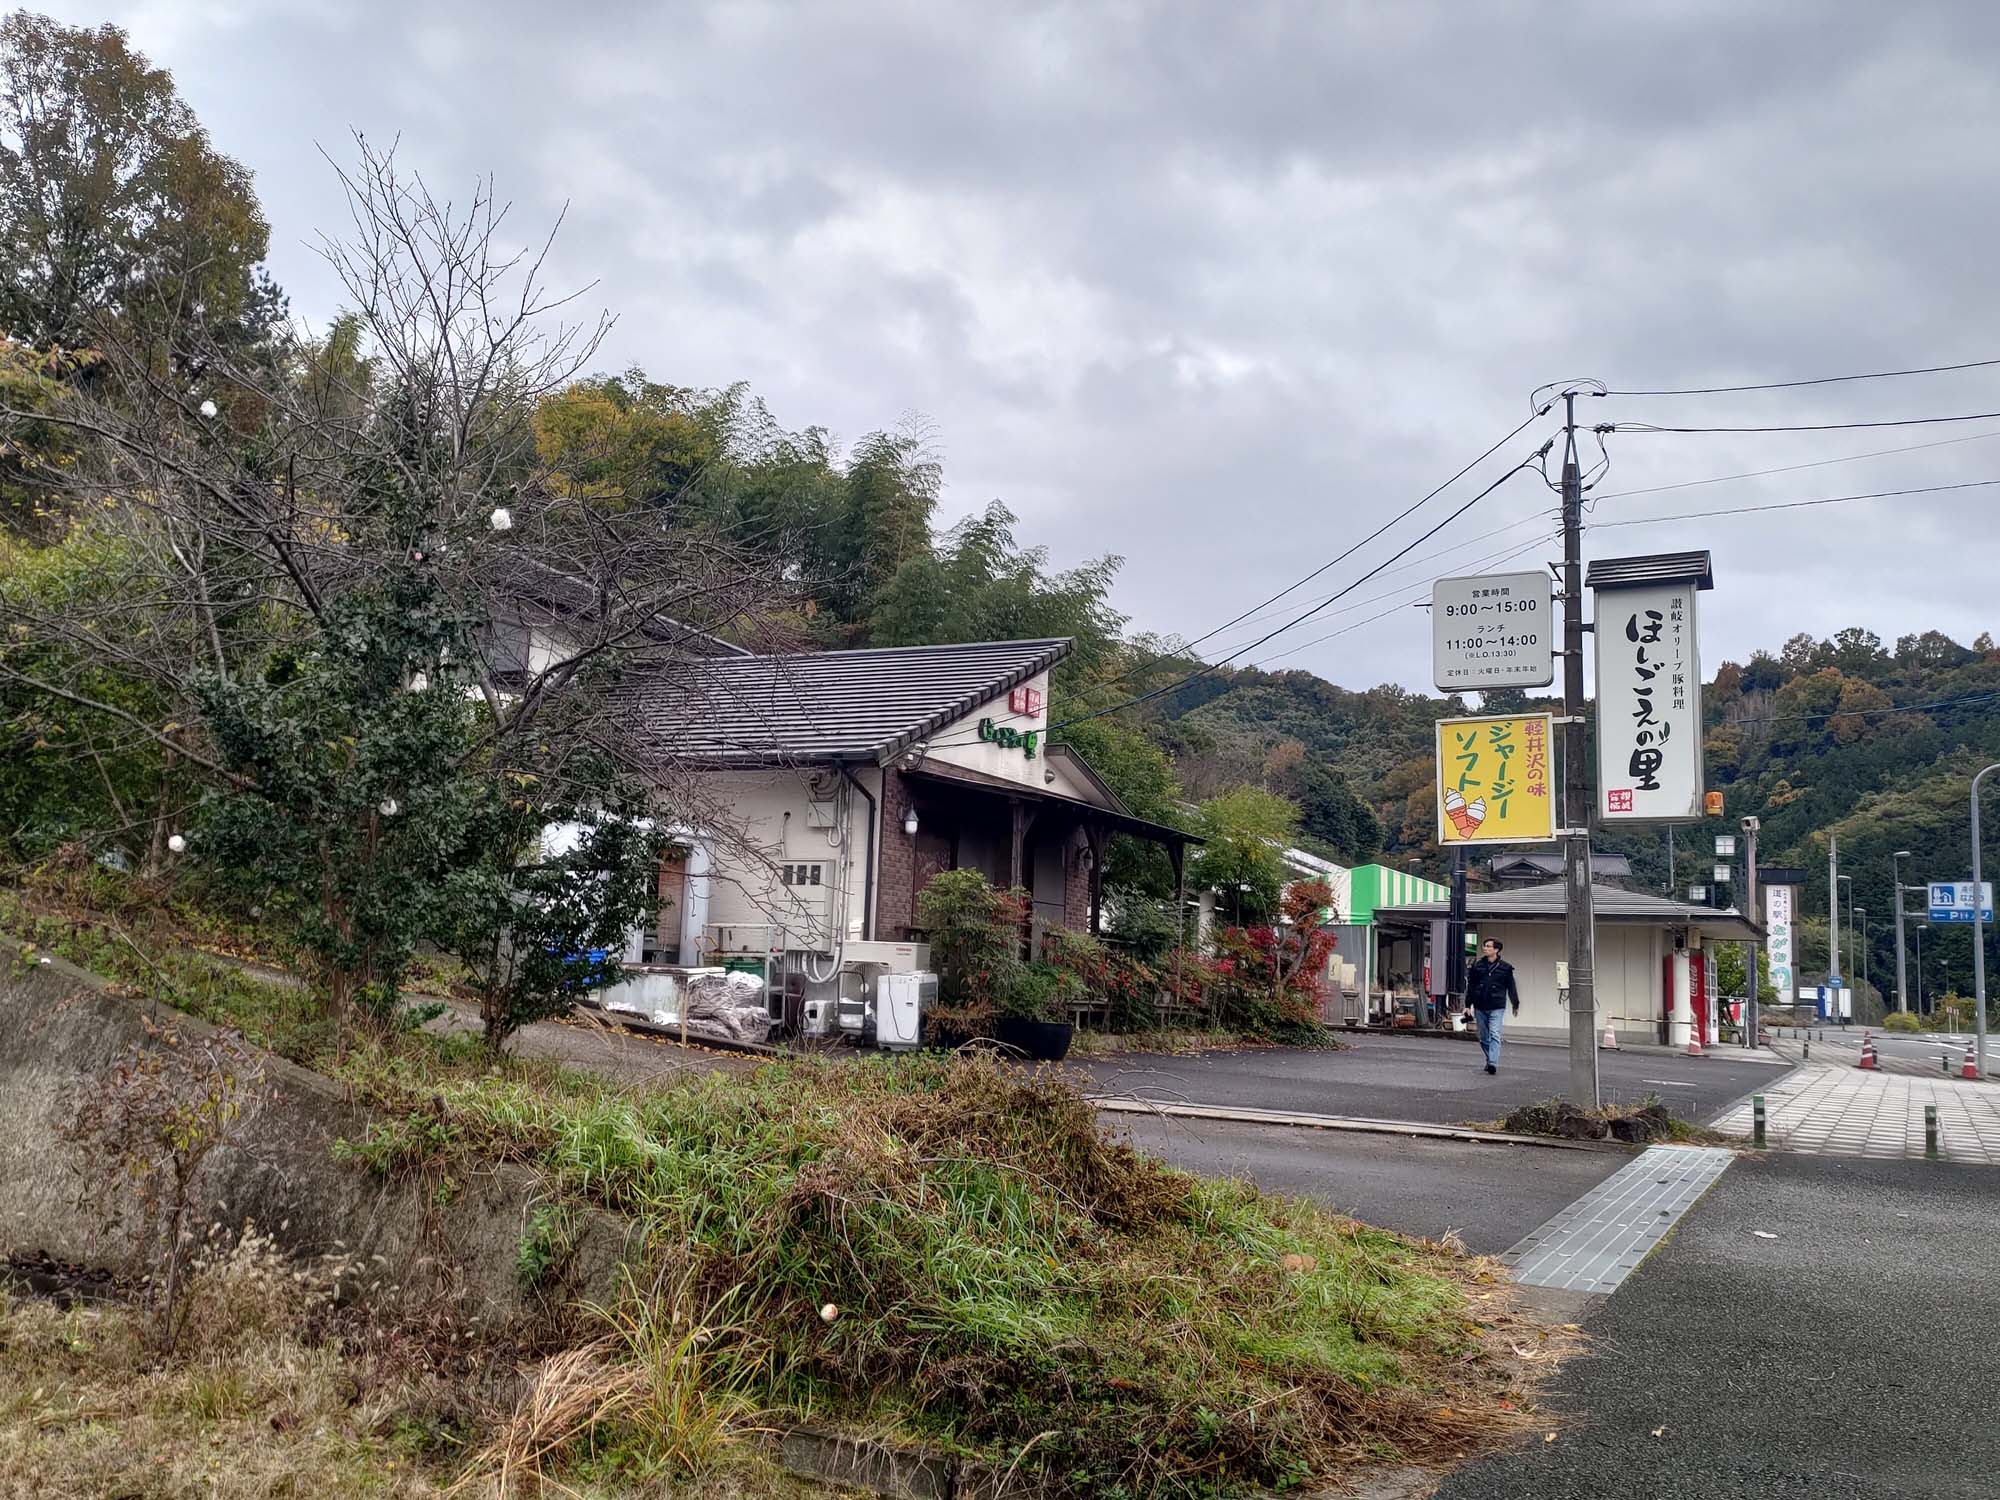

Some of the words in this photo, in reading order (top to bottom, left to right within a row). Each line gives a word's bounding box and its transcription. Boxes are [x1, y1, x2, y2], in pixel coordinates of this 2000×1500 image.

[1472, 587, 1510, 598] 営業時間
[1477, 623, 1505, 634] ランチ
[1670, 598, 1685, 710] 讃岐オリーブ豚料理
[1626, 610, 1665, 791] ほしごえの里
[1456, 730, 1481, 793] ソフト
[1488, 721, 1516, 820] ジャージー
[1524, 720, 1547, 798] 軽井沢の味
